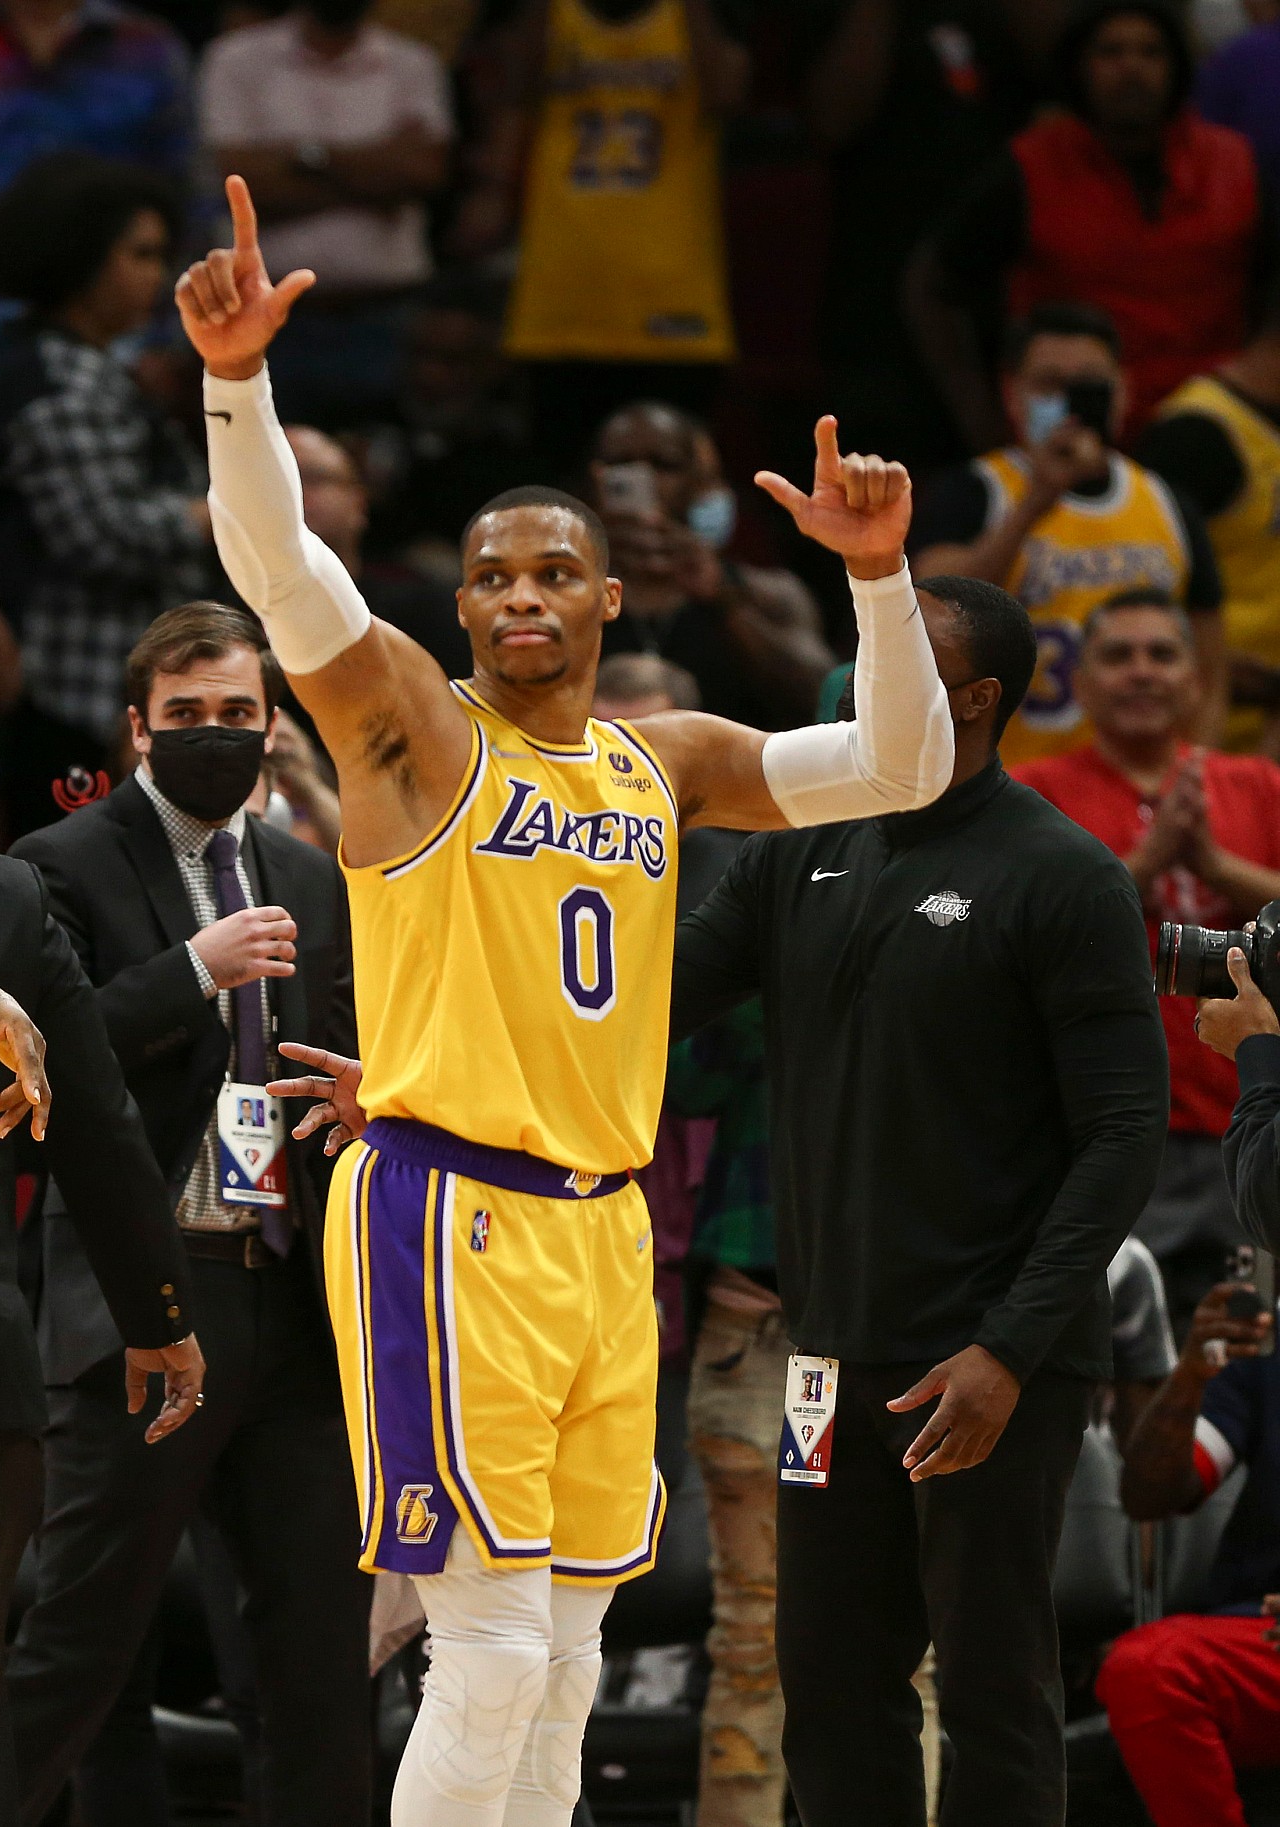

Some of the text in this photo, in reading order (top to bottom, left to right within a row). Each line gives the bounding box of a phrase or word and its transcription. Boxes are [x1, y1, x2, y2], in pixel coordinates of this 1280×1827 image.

[608, 773, 652, 793] bibigo
[471, 776, 668, 882] LAKERS
[913, 894, 971, 922] LAKERS
[558, 884, 616, 1022] 0
